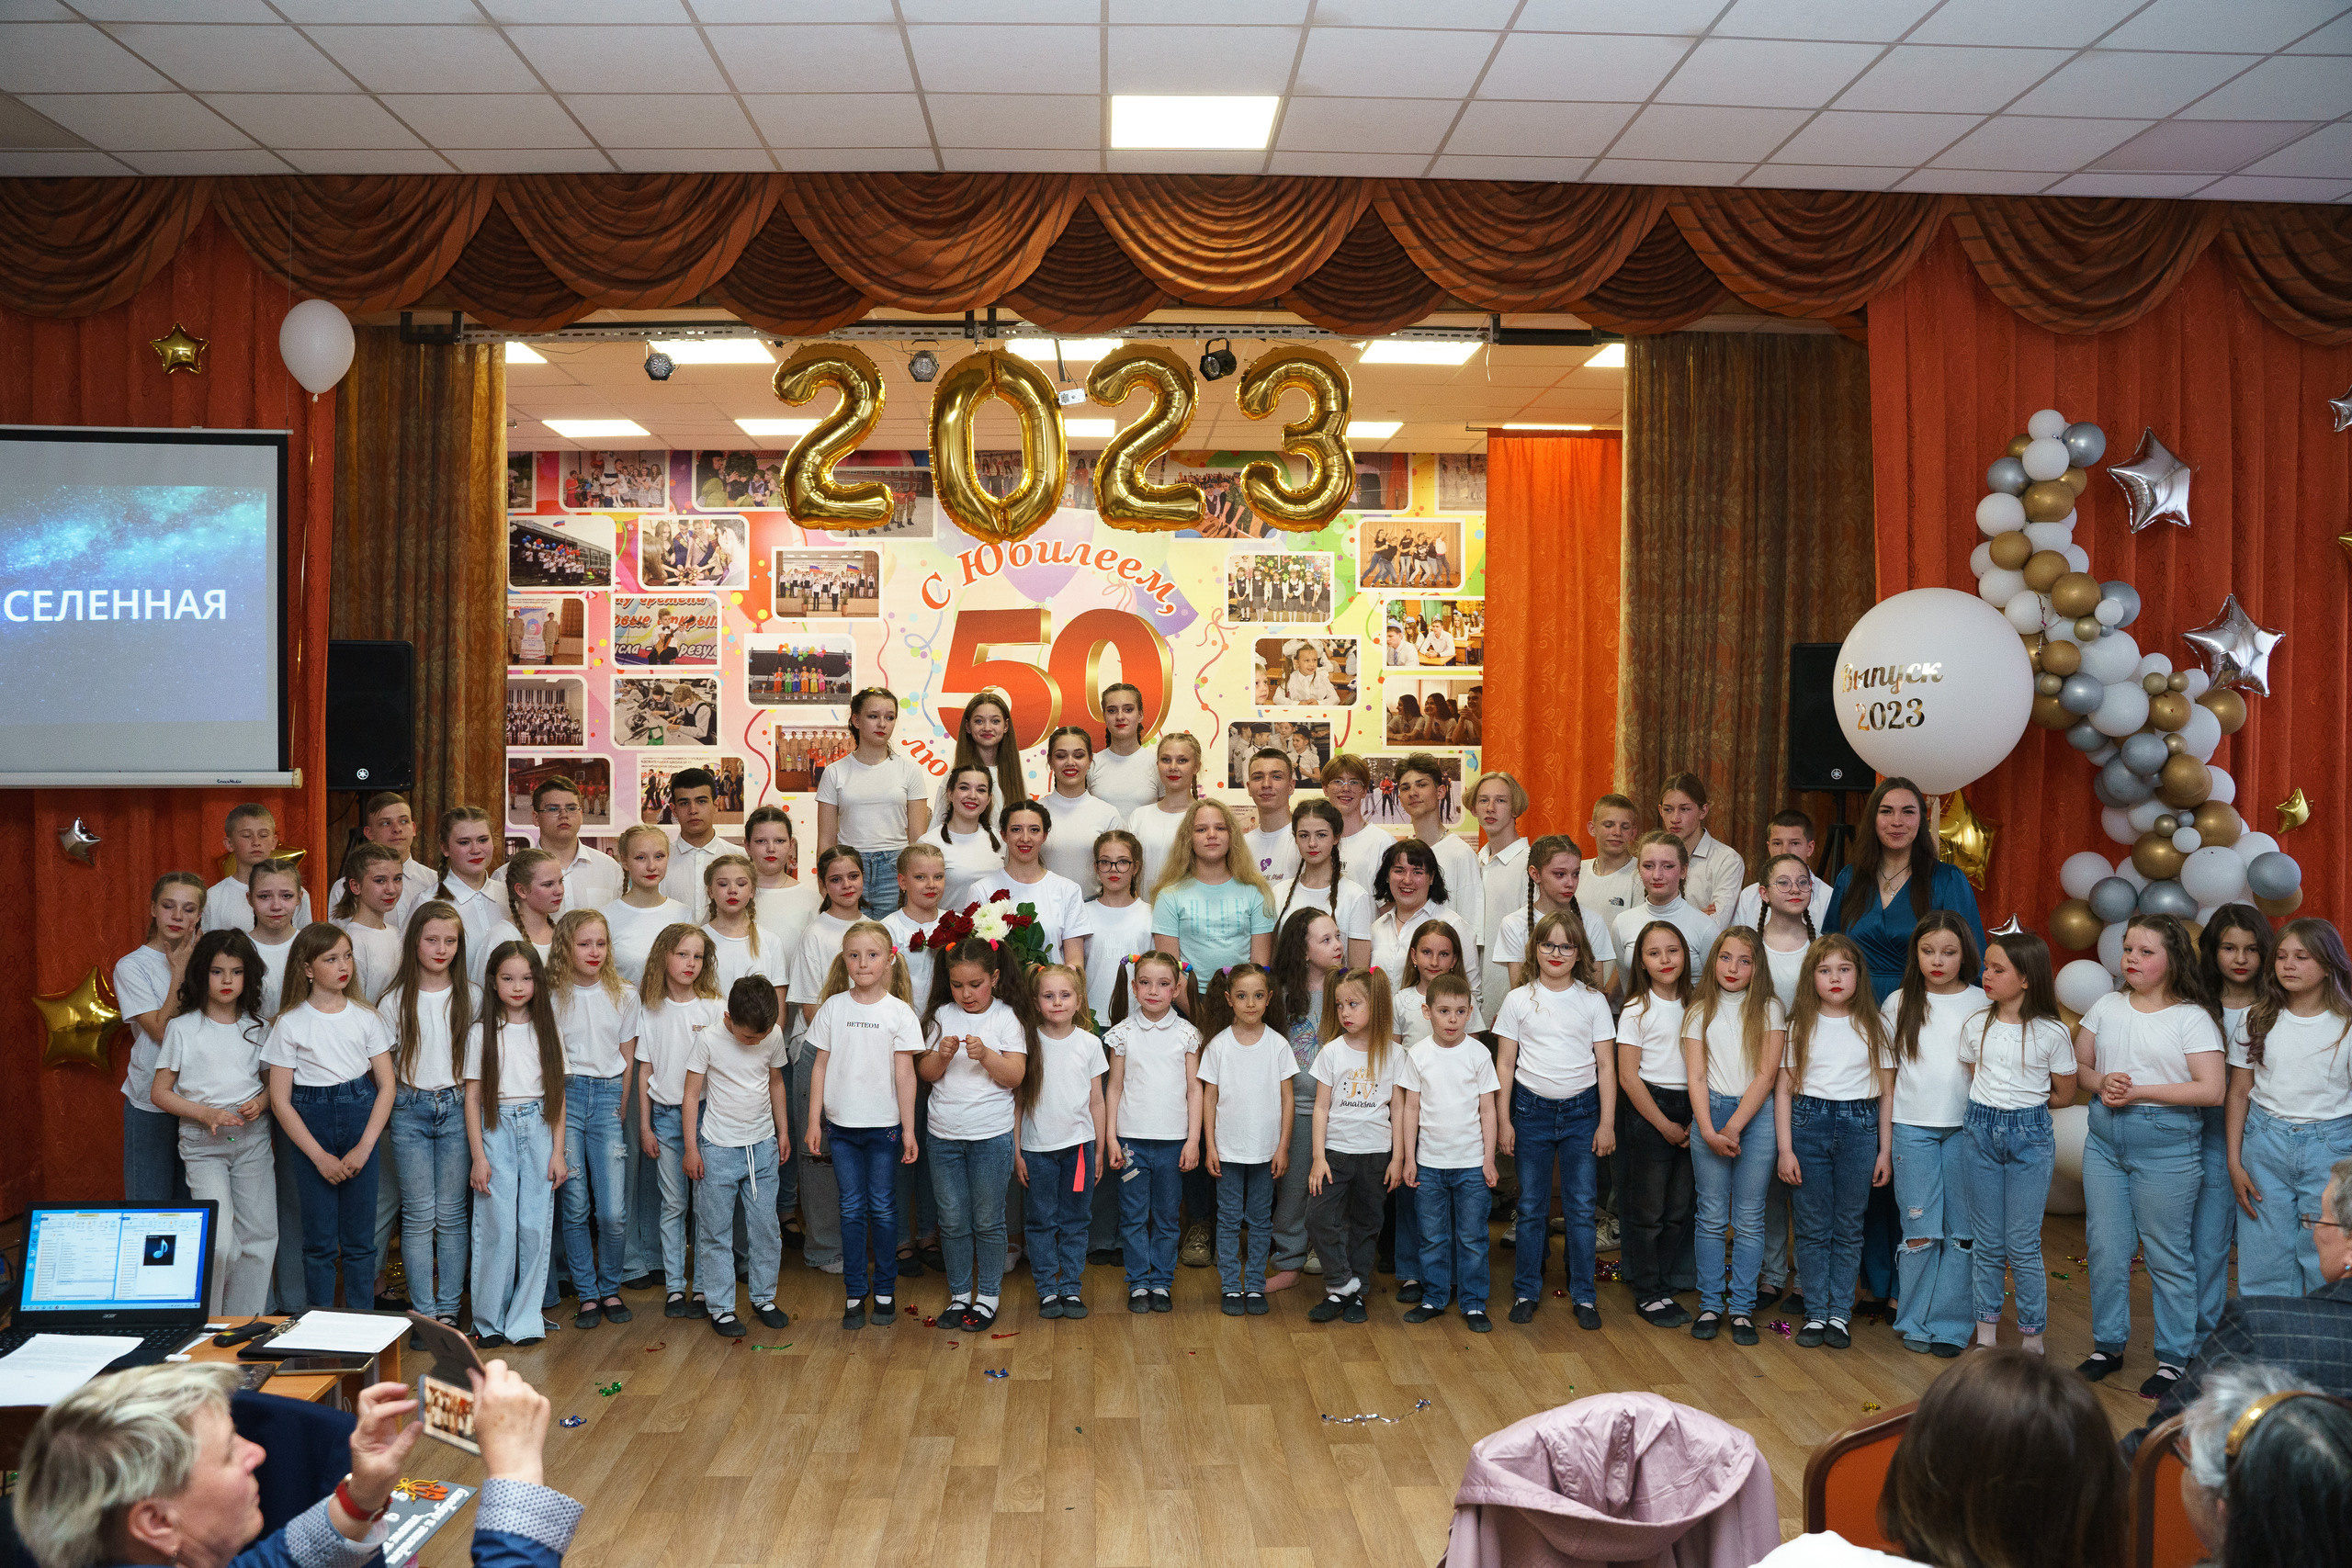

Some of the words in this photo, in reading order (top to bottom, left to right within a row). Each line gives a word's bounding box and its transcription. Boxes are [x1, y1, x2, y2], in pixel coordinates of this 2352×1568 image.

[773, 343, 1354, 542] 2023
[3, 589, 227, 622] СЕЛЕННАЯ
[921, 571, 951, 610] С
[956, 536, 1176, 615] Юбилеем,
[937, 608, 1173, 754] 50
[1855, 698, 1926, 731] 2023
